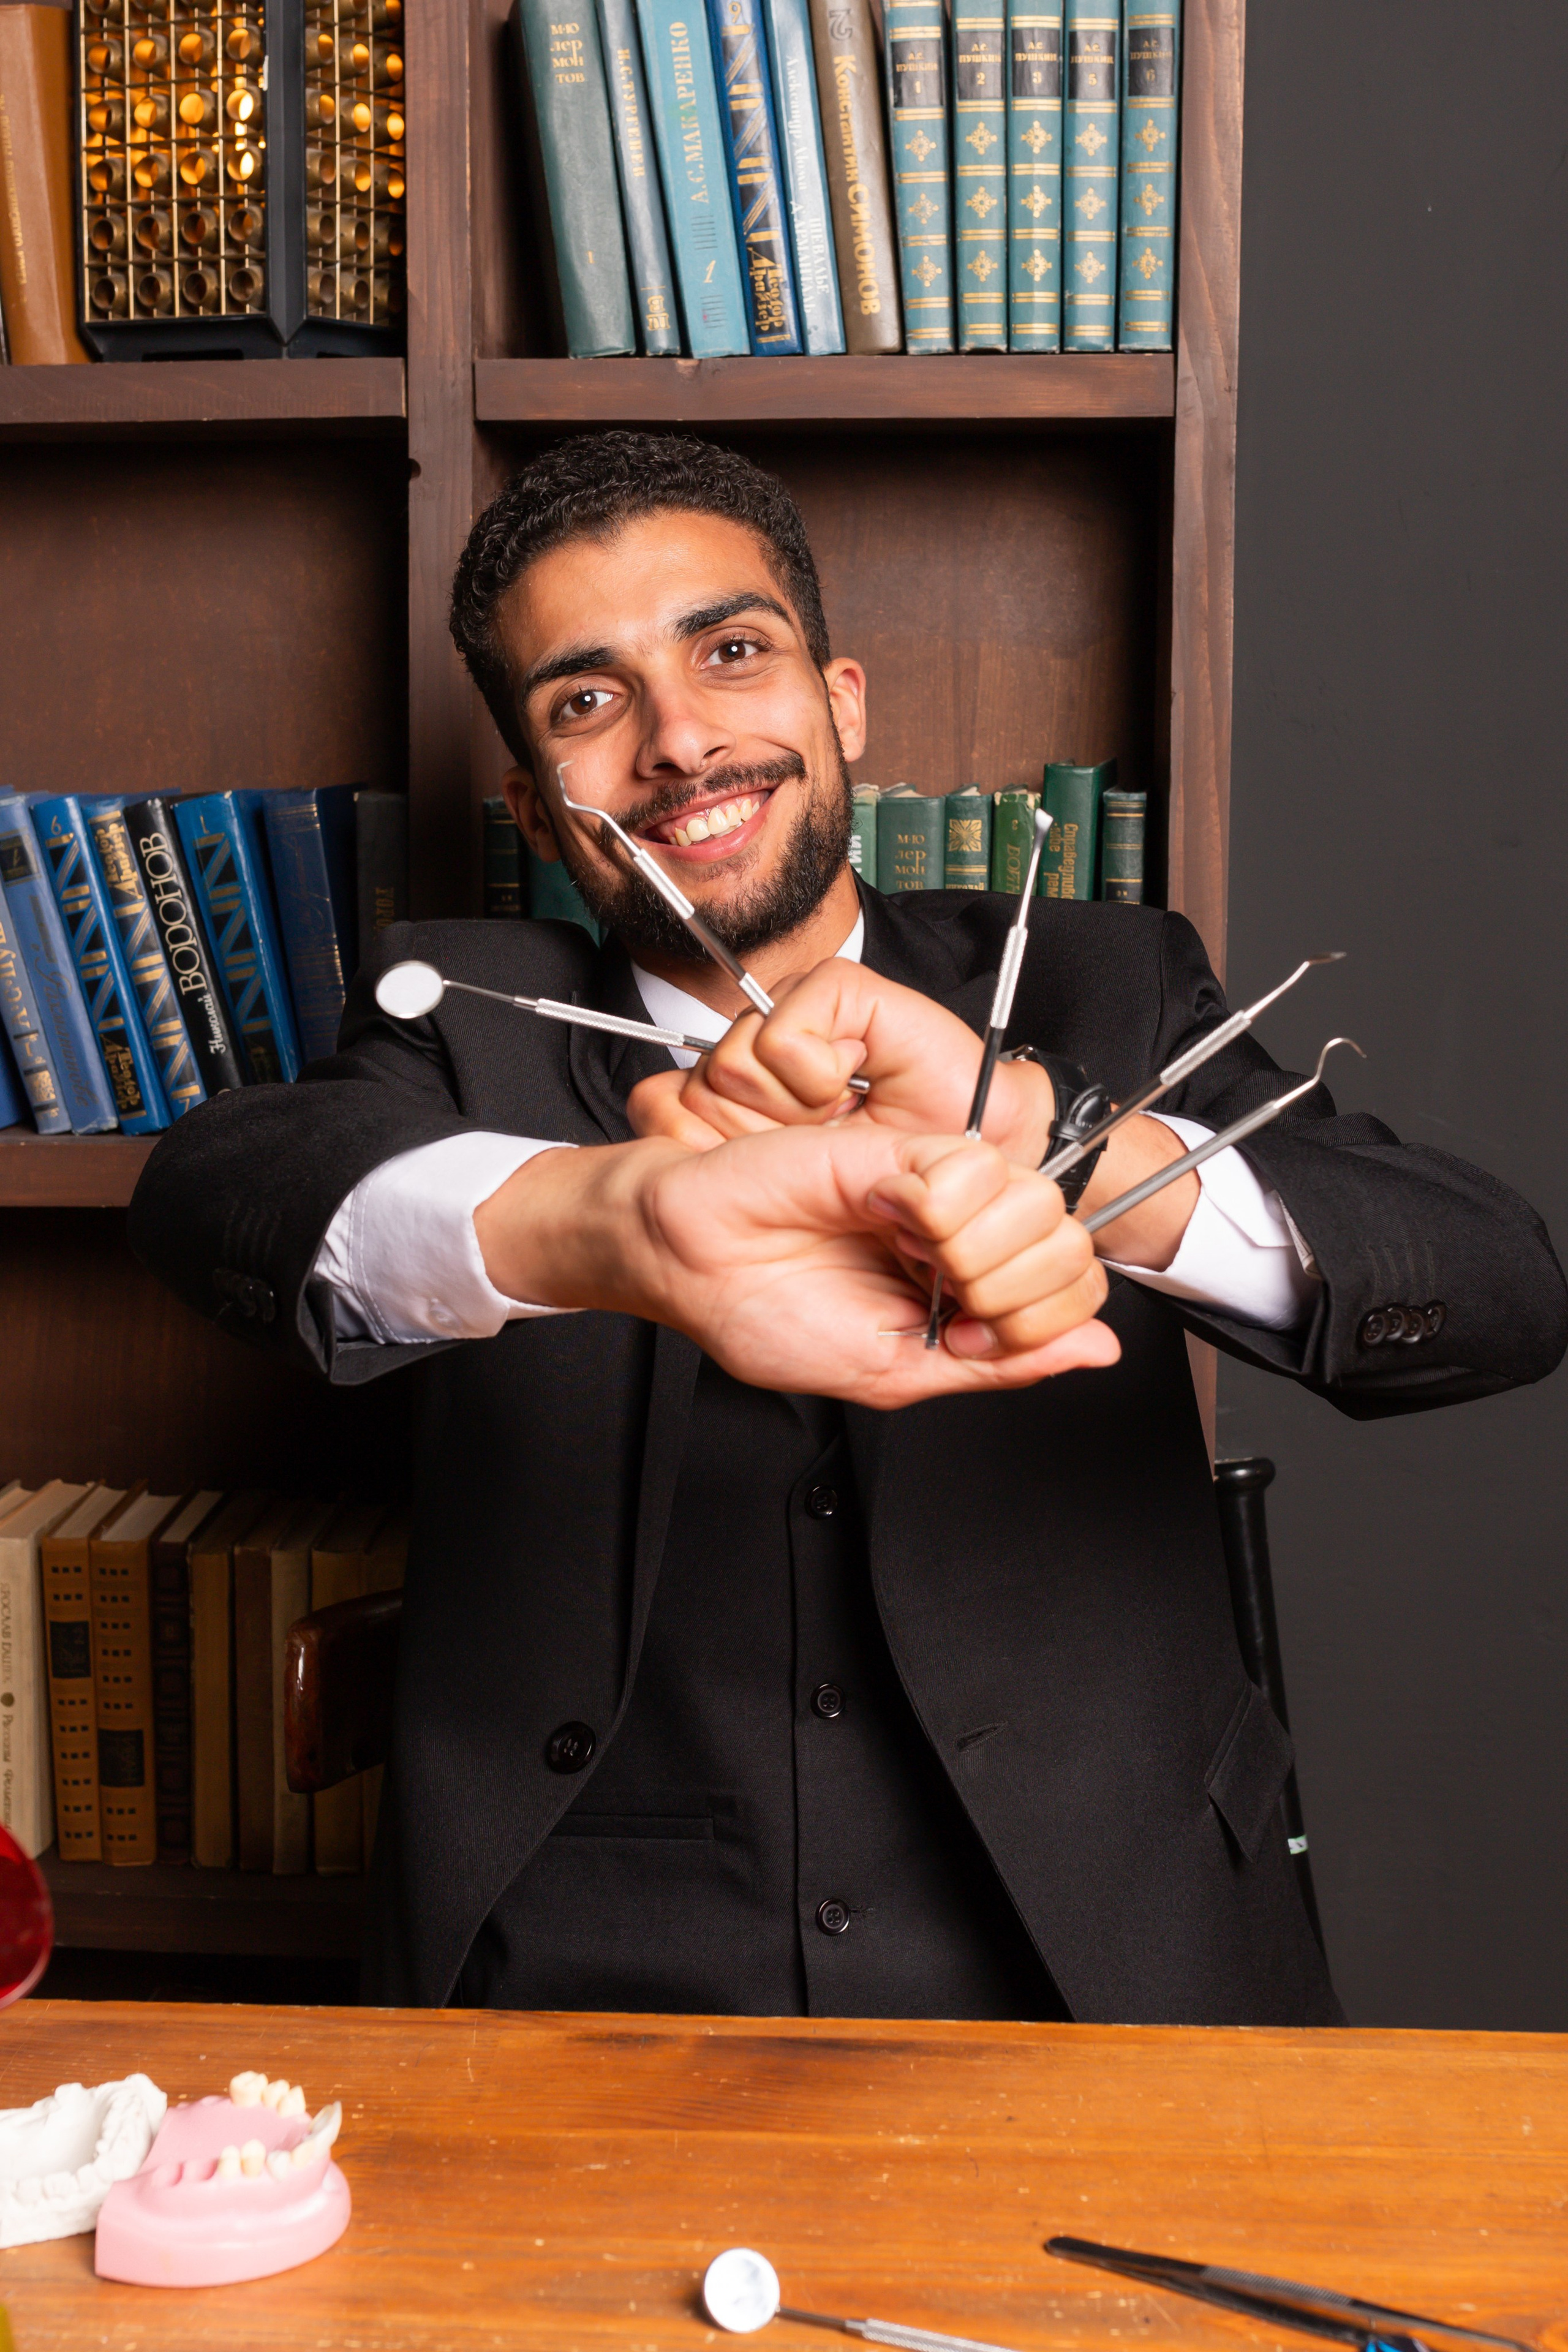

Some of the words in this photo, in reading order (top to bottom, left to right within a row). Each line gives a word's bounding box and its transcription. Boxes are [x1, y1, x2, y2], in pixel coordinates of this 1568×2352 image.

[977, 72, 986, 85] 2
[1032, 71, 1042, 84] 3
[1088, 74, 1098, 86] 5
[1146, 69, 1156, 82] 6
[915, 80, 922, 94] 1
[847, 184, 881, 316] СИМОНОВ
[703, 260, 717, 284] 1
